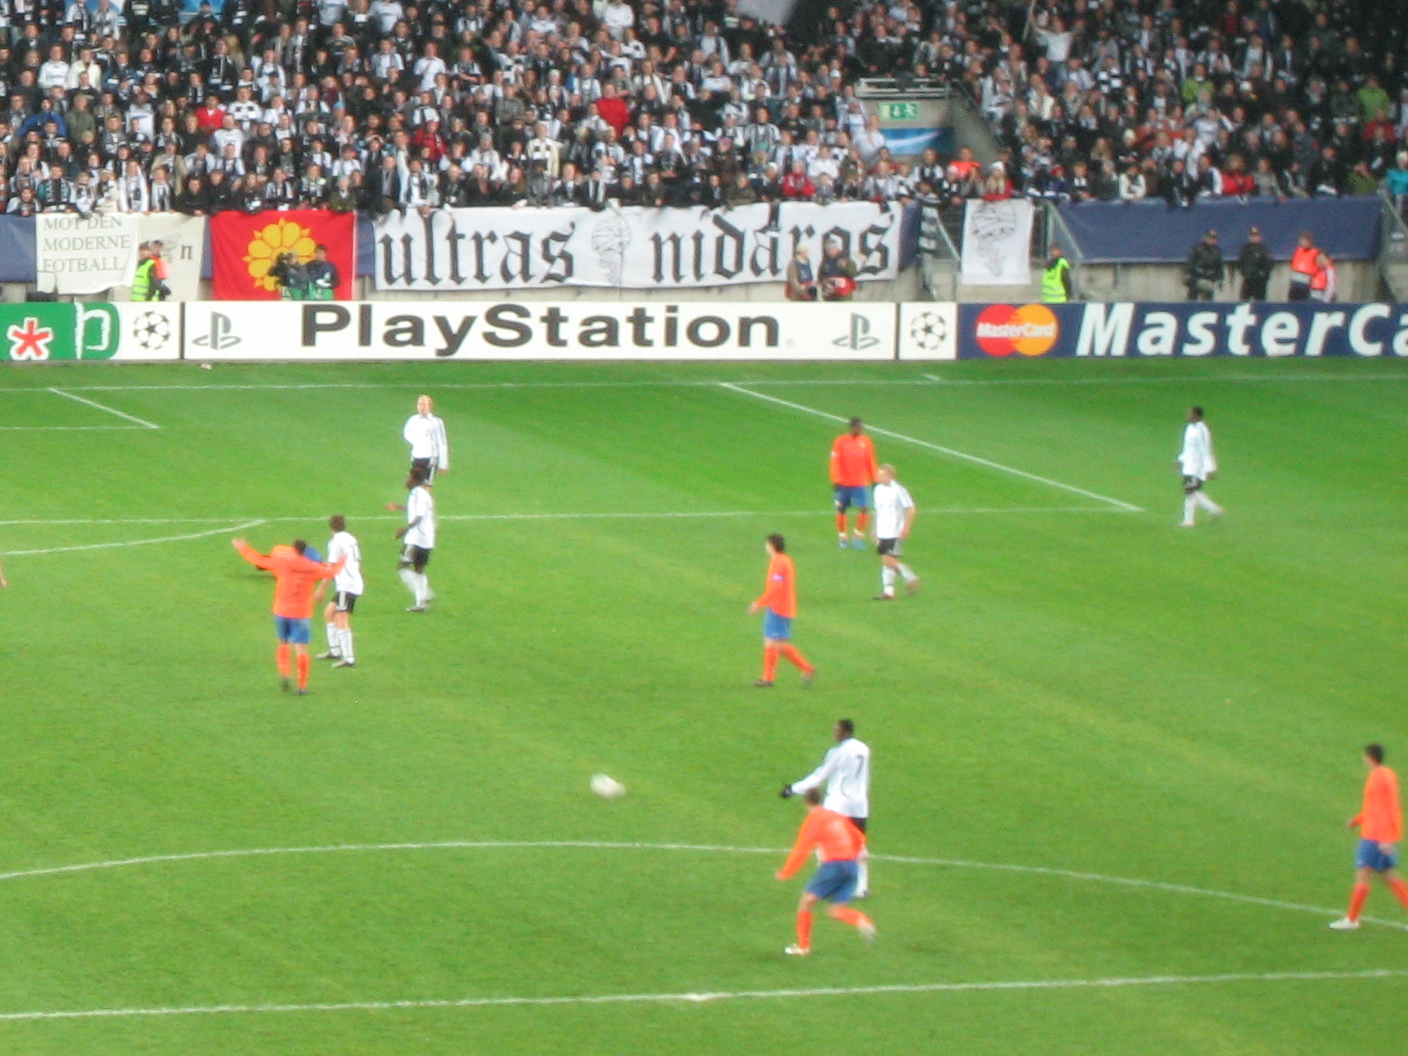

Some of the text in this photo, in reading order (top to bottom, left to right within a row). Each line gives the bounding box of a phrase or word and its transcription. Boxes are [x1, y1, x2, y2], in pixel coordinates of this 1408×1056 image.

[44, 214, 122, 231] MOT DEN
[44, 234, 131, 252] MODERNE
[378, 210, 575, 285] ultras
[44, 257, 125, 273] FOTBALL
[301, 304, 780, 357] PlayStation
[975, 322, 1057, 339] MasterCard
